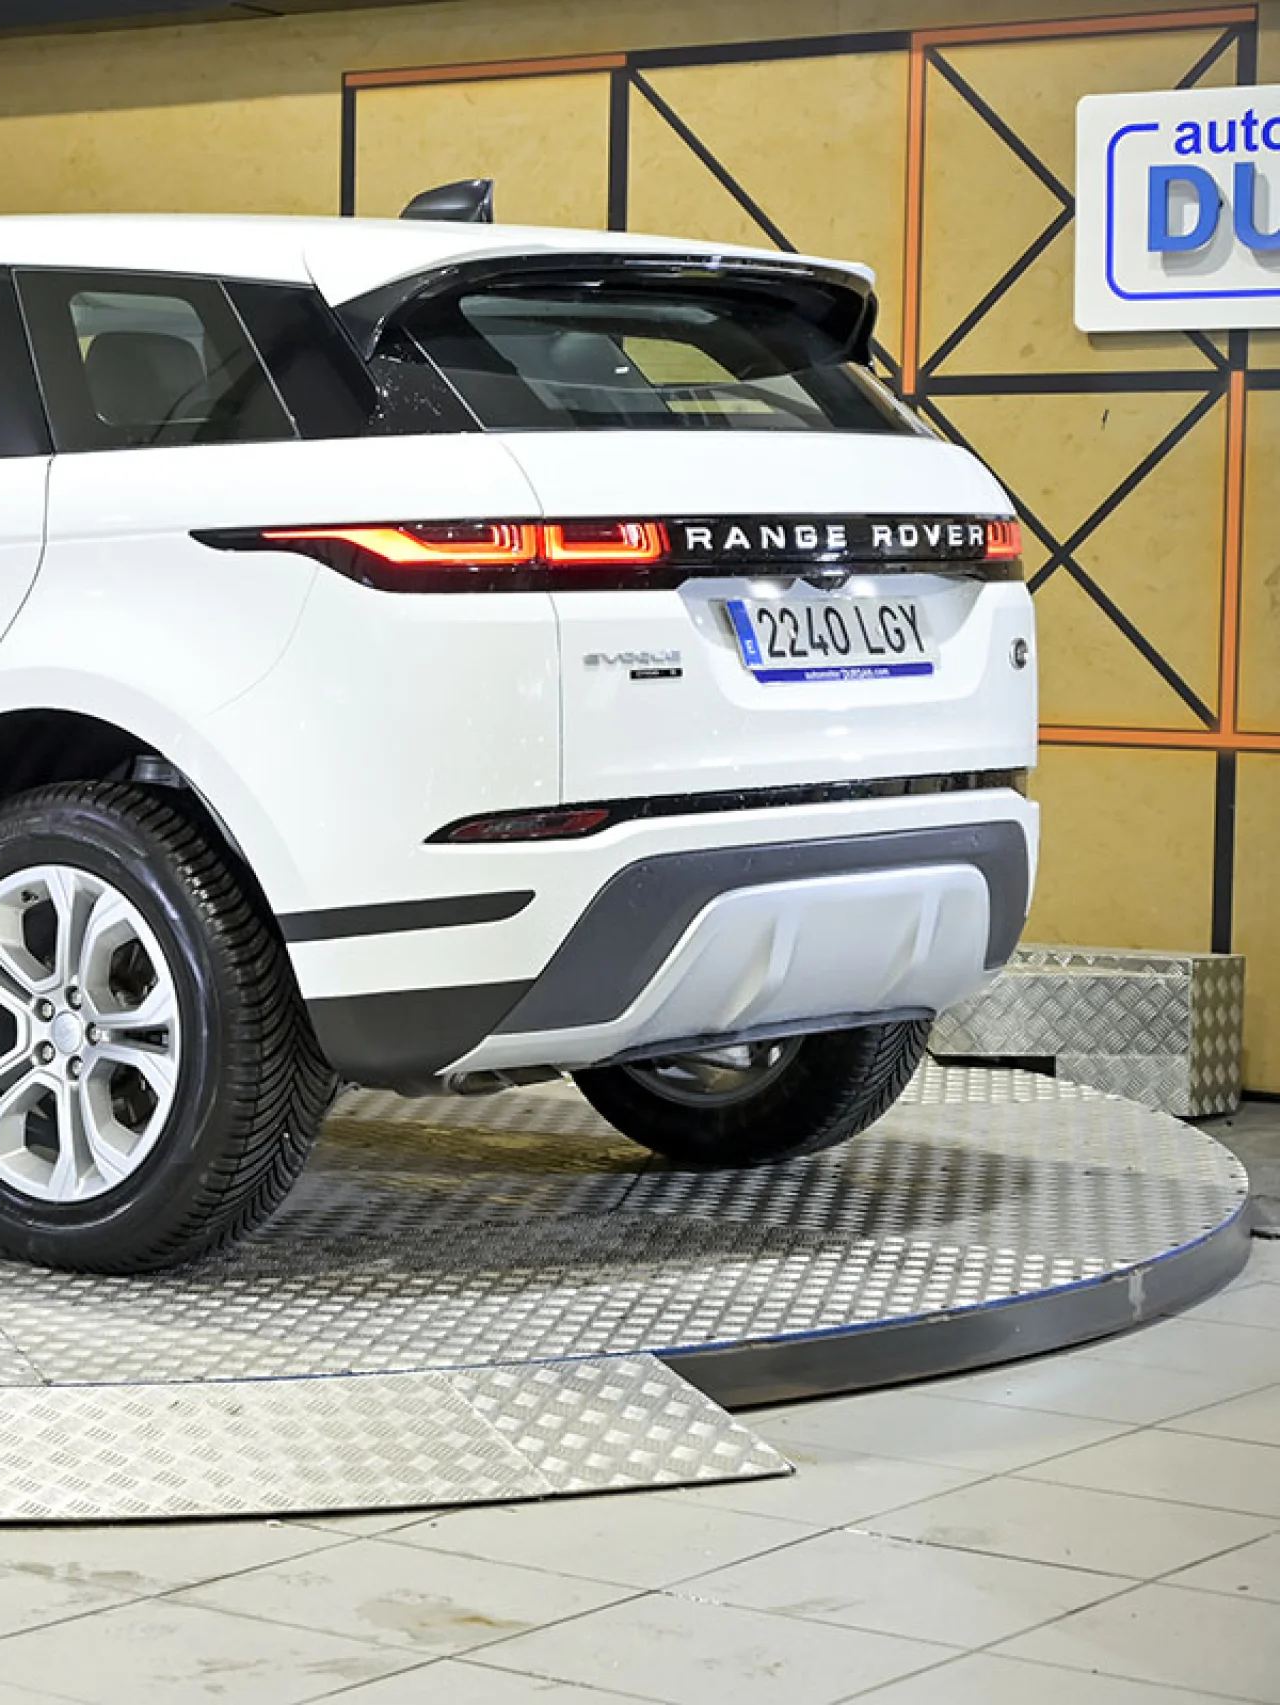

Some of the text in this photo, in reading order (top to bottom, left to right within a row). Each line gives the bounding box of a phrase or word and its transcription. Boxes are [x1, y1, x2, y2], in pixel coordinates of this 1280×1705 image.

[685, 524, 984, 549] RANGE ROVER
[757, 603, 925, 658] 2240 LGY
